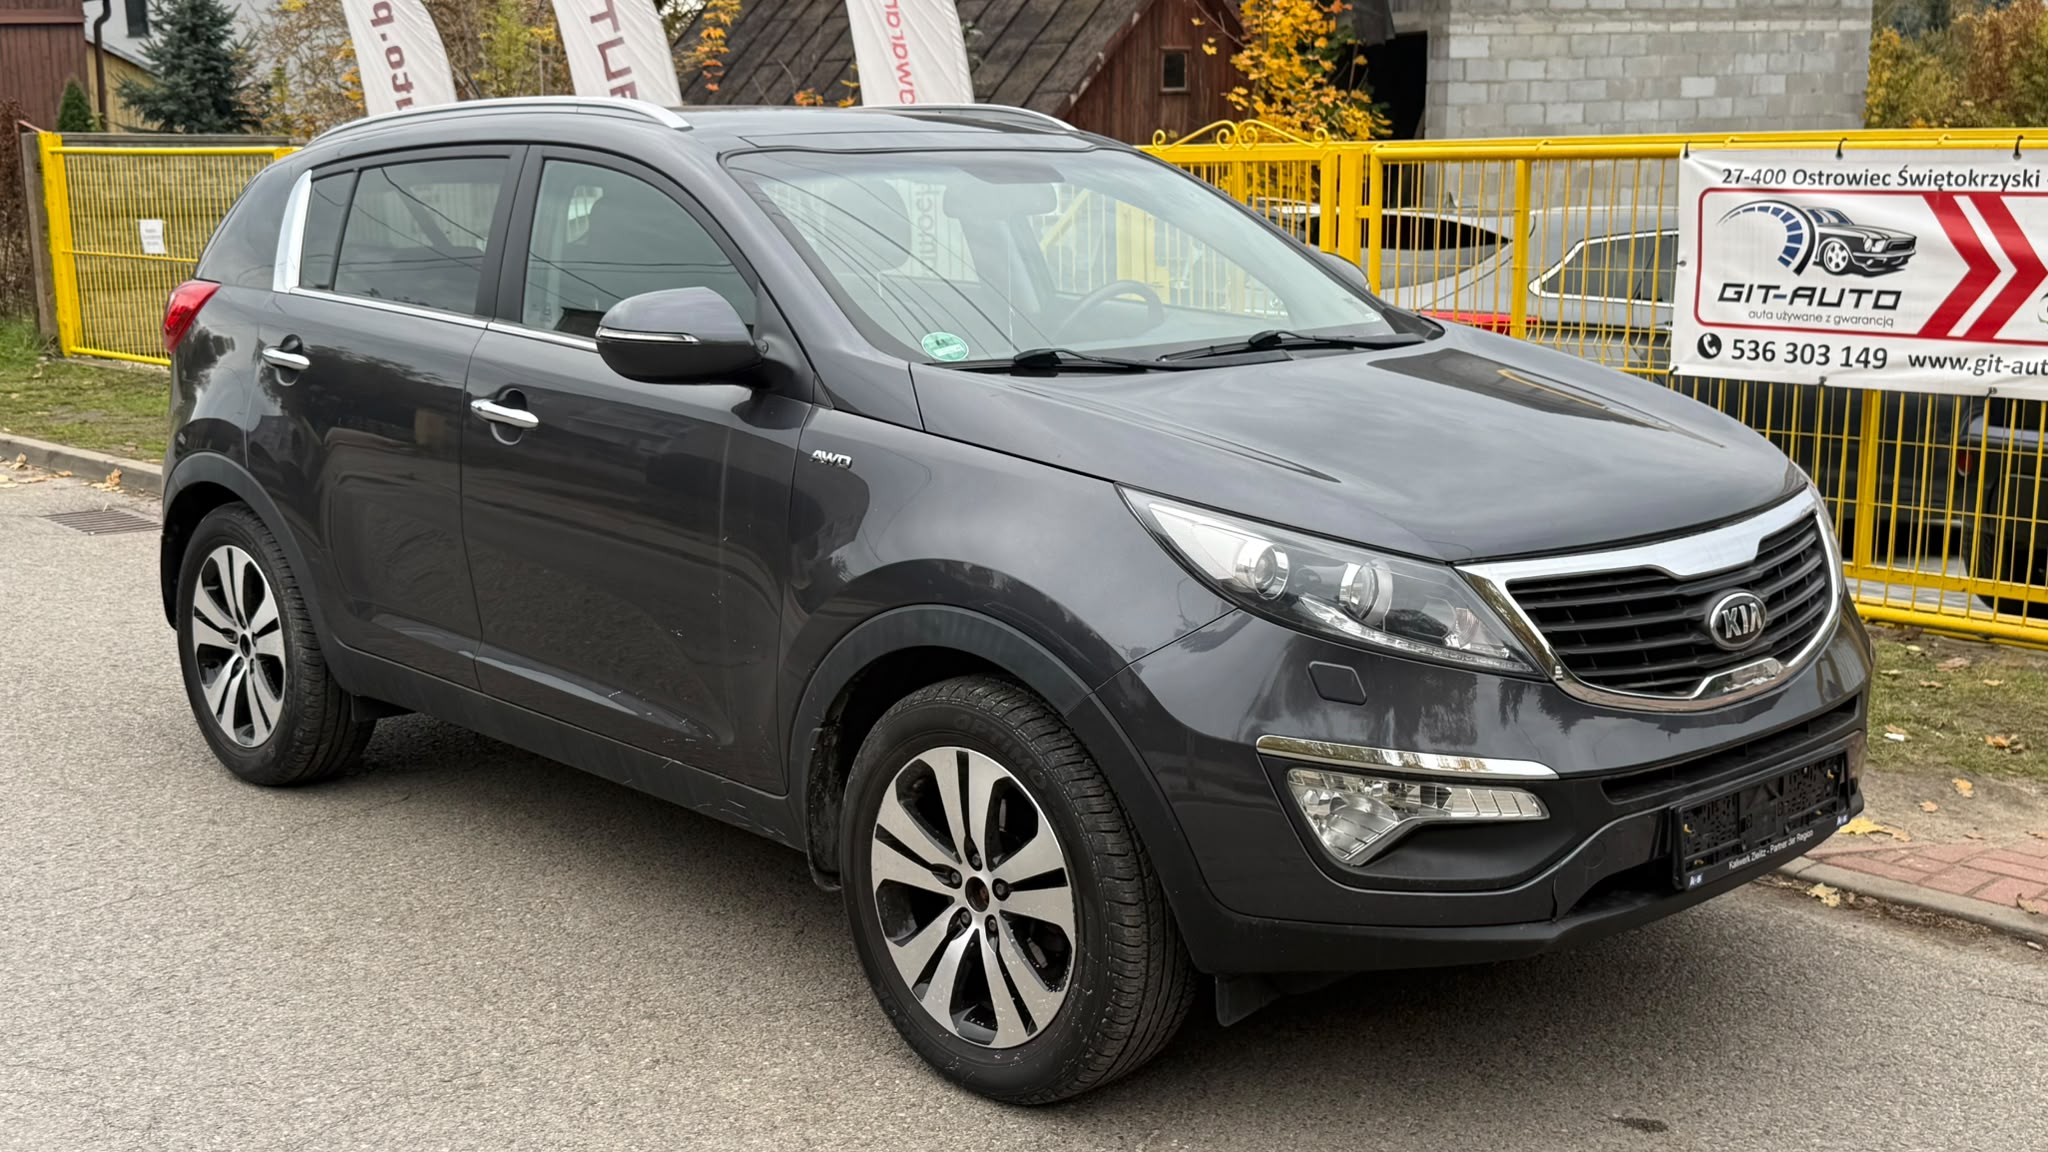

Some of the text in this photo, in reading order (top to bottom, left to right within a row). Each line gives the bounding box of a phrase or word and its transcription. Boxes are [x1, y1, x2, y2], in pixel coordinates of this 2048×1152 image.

[1722, 164, 2041, 192] 27-400 Ostrowiec Świętokrzyski
[1717, 283, 1902, 310] GIT-AUTO
[1748, 310, 1894, 328] auta używane z gwarancją
[1731, 339, 1888, 369] 536 303 149
[810, 449, 852, 468] AWD
[1721, 602, 1762, 639] KIA
